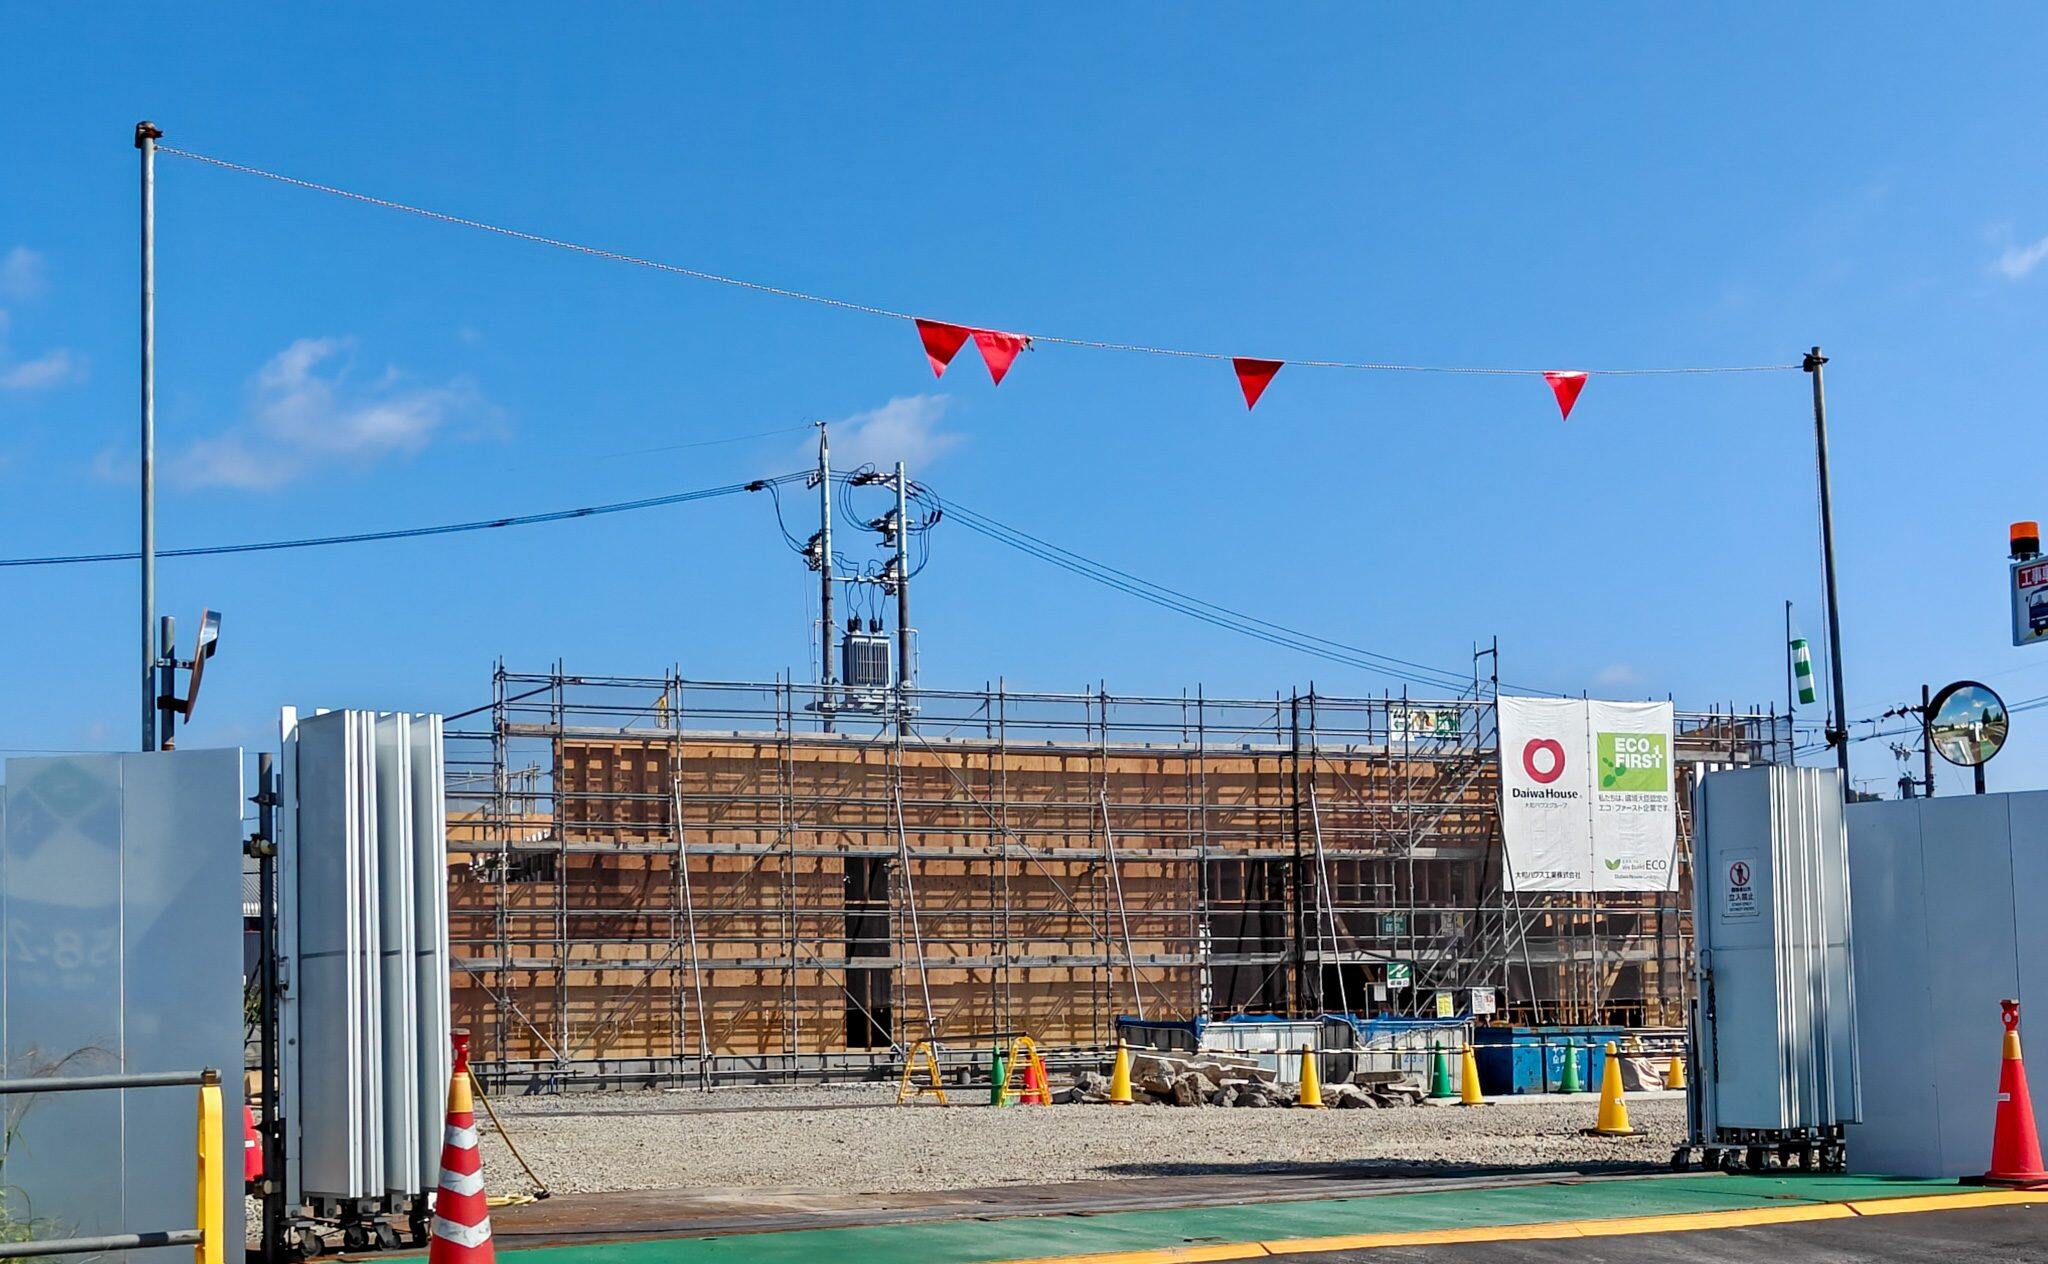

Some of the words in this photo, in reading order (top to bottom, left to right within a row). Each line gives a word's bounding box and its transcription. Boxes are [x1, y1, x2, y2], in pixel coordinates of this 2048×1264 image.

[1615, 736, 1650, 753] ECO
[1615, 745, 1663, 769] FIRST
[1645, 859, 1667, 870] ECO
